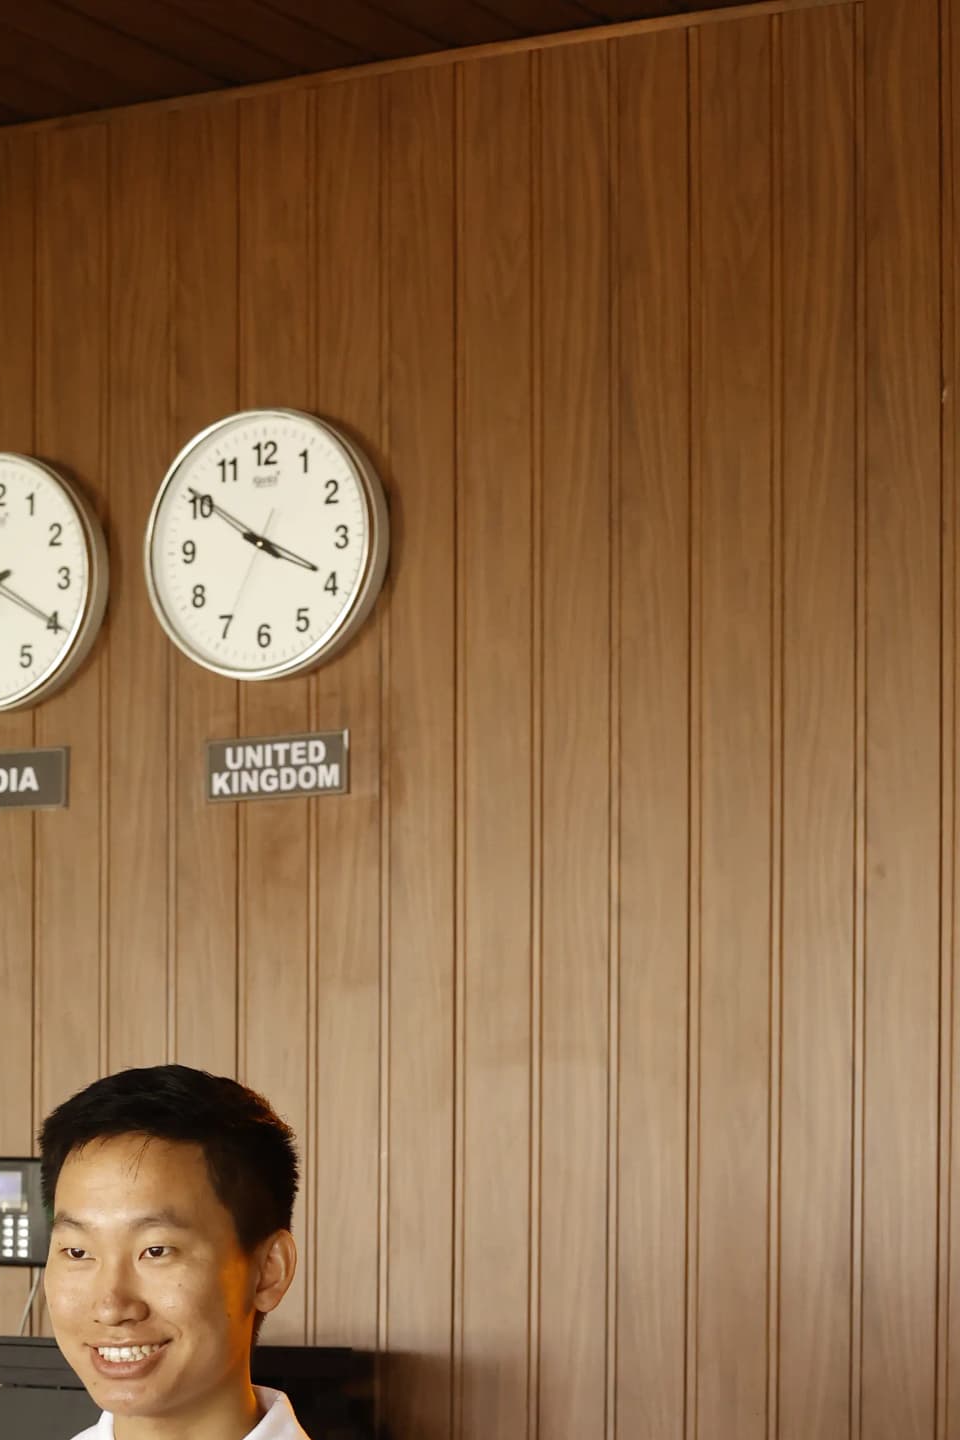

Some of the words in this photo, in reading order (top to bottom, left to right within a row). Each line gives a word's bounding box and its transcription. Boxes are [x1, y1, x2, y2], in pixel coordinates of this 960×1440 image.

[252, 440, 278, 467] 12
[298, 449, 309, 474] 1
[217, 457, 238, 483] 11
[25, 492, 35, 516] 1
[324, 479, 340, 505] 2
[188, 494, 214, 520] 10
[48, 522, 63, 547] 2
[334, 524, 350, 550] 3
[181, 540, 197, 565] 9
[57, 566, 71, 591] 3
[323, 571, 339, 597] 4
[191, 584, 206, 609] 8
[46, 611, 63, 635] 4
[218, 614, 234, 640] 7
[295, 607, 310, 633] 5
[256, 623, 272, 649] 6
[19, 644, 33, 669] 5
[224, 739, 327, 771] UNITED
[211, 763, 340, 796] KINGDOM
